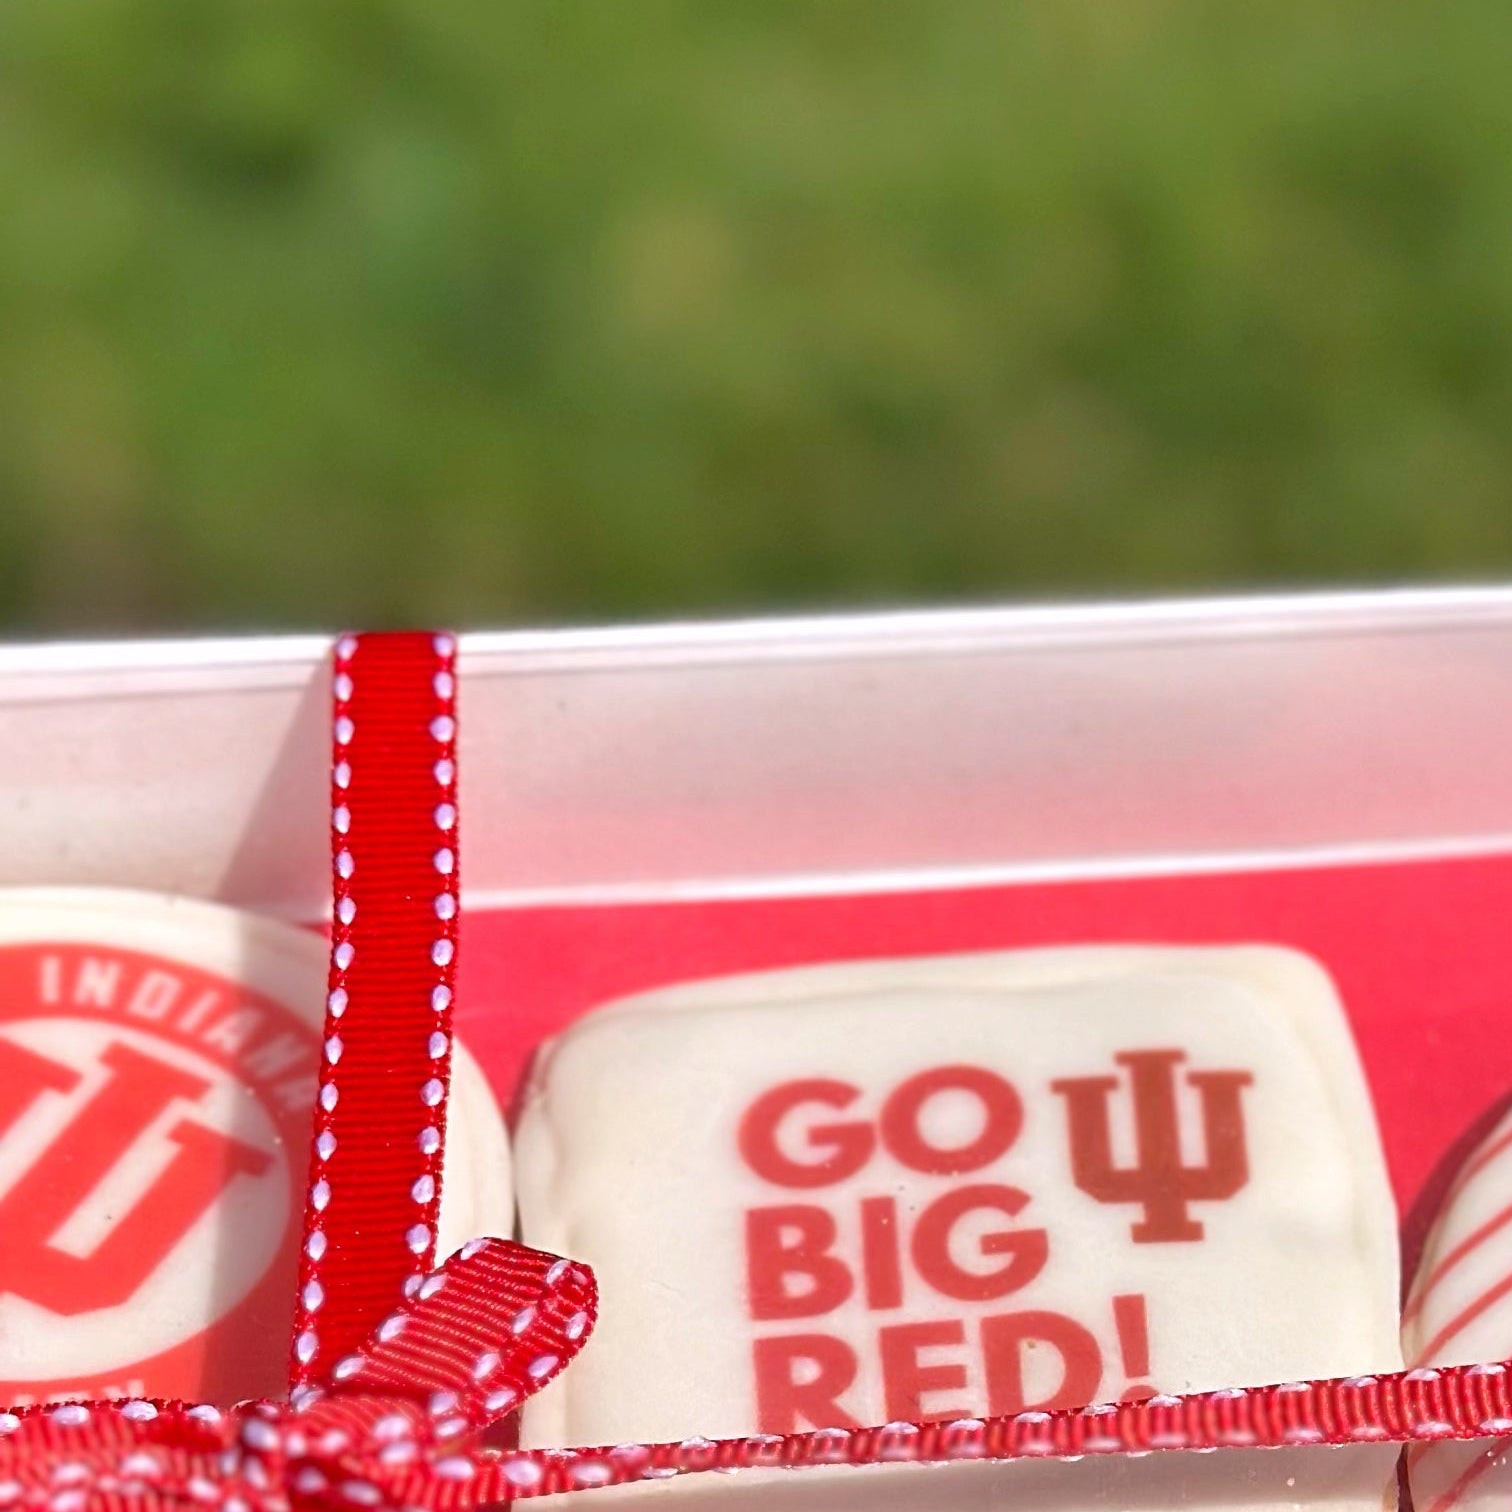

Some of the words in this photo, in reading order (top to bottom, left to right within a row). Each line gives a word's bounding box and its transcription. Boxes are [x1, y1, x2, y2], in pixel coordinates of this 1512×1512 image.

[737, 1063, 1026, 1189] GO
[744, 1183, 1050, 1322] BIG
[752, 1293, 1160, 1436] RED!
